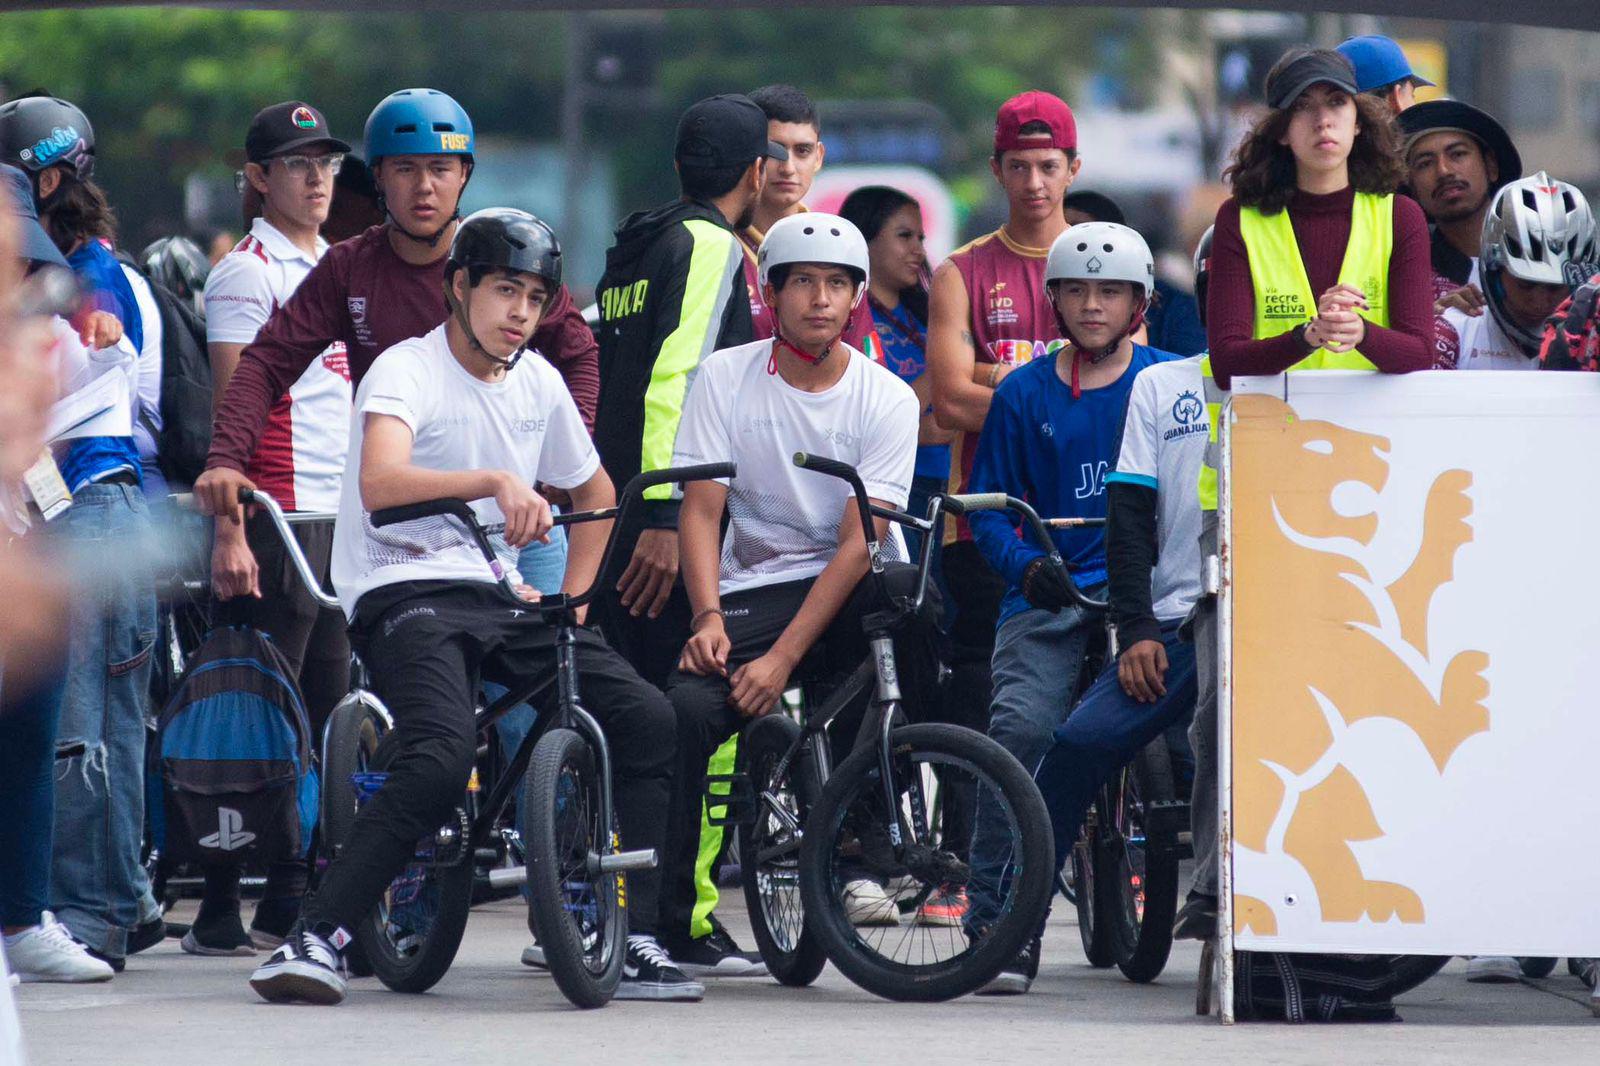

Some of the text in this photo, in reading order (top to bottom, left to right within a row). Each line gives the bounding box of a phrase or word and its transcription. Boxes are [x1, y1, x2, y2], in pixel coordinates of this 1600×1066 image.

[441, 133, 467, 150] FUSE
[990, 297, 1013, 309] IVD
[1265, 294, 1299, 304] recre
[1265, 303, 1305, 314] activa
[987, 339, 1072, 362] VERAC
